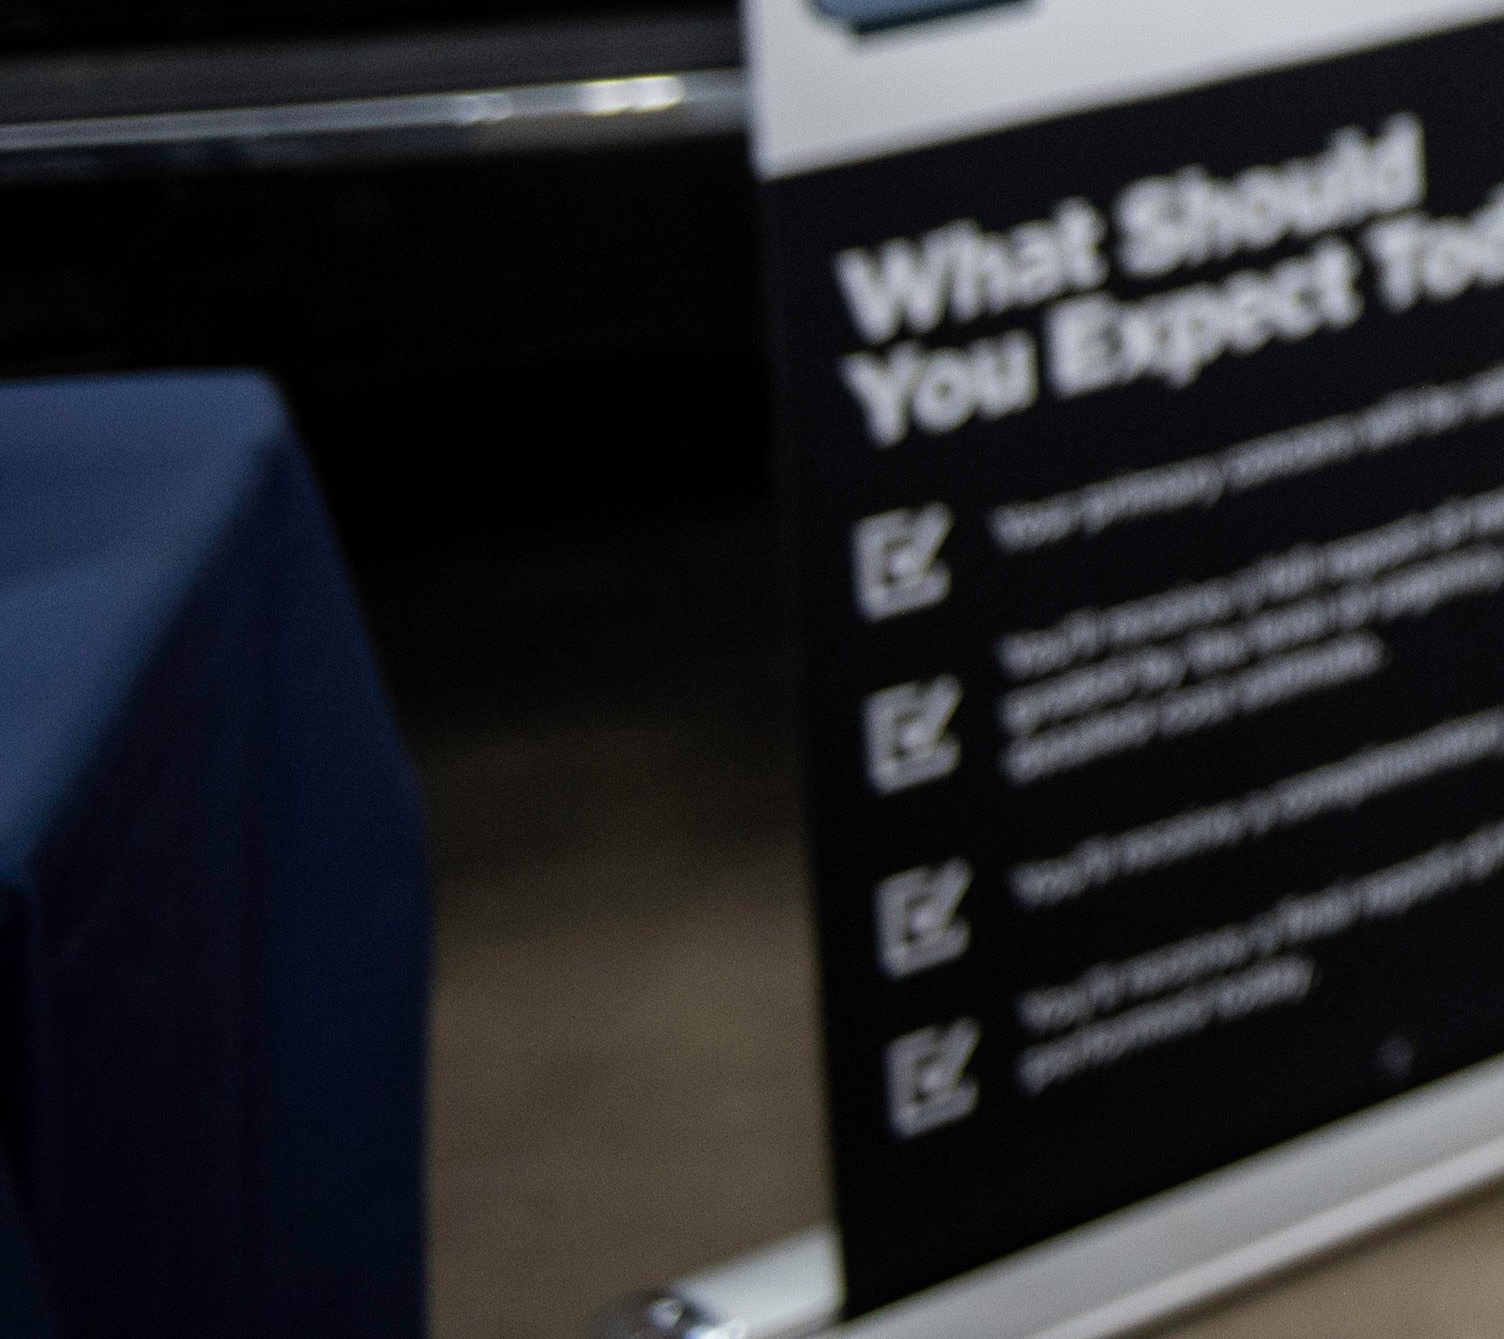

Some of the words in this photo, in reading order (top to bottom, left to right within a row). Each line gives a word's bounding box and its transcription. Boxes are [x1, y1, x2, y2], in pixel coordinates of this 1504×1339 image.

[833, 196, 1110, 345] What
[1112, 110, 1428, 271] Should
[843, 329, 1039, 451] You
[1040, 241, 1366, 401] Expect
